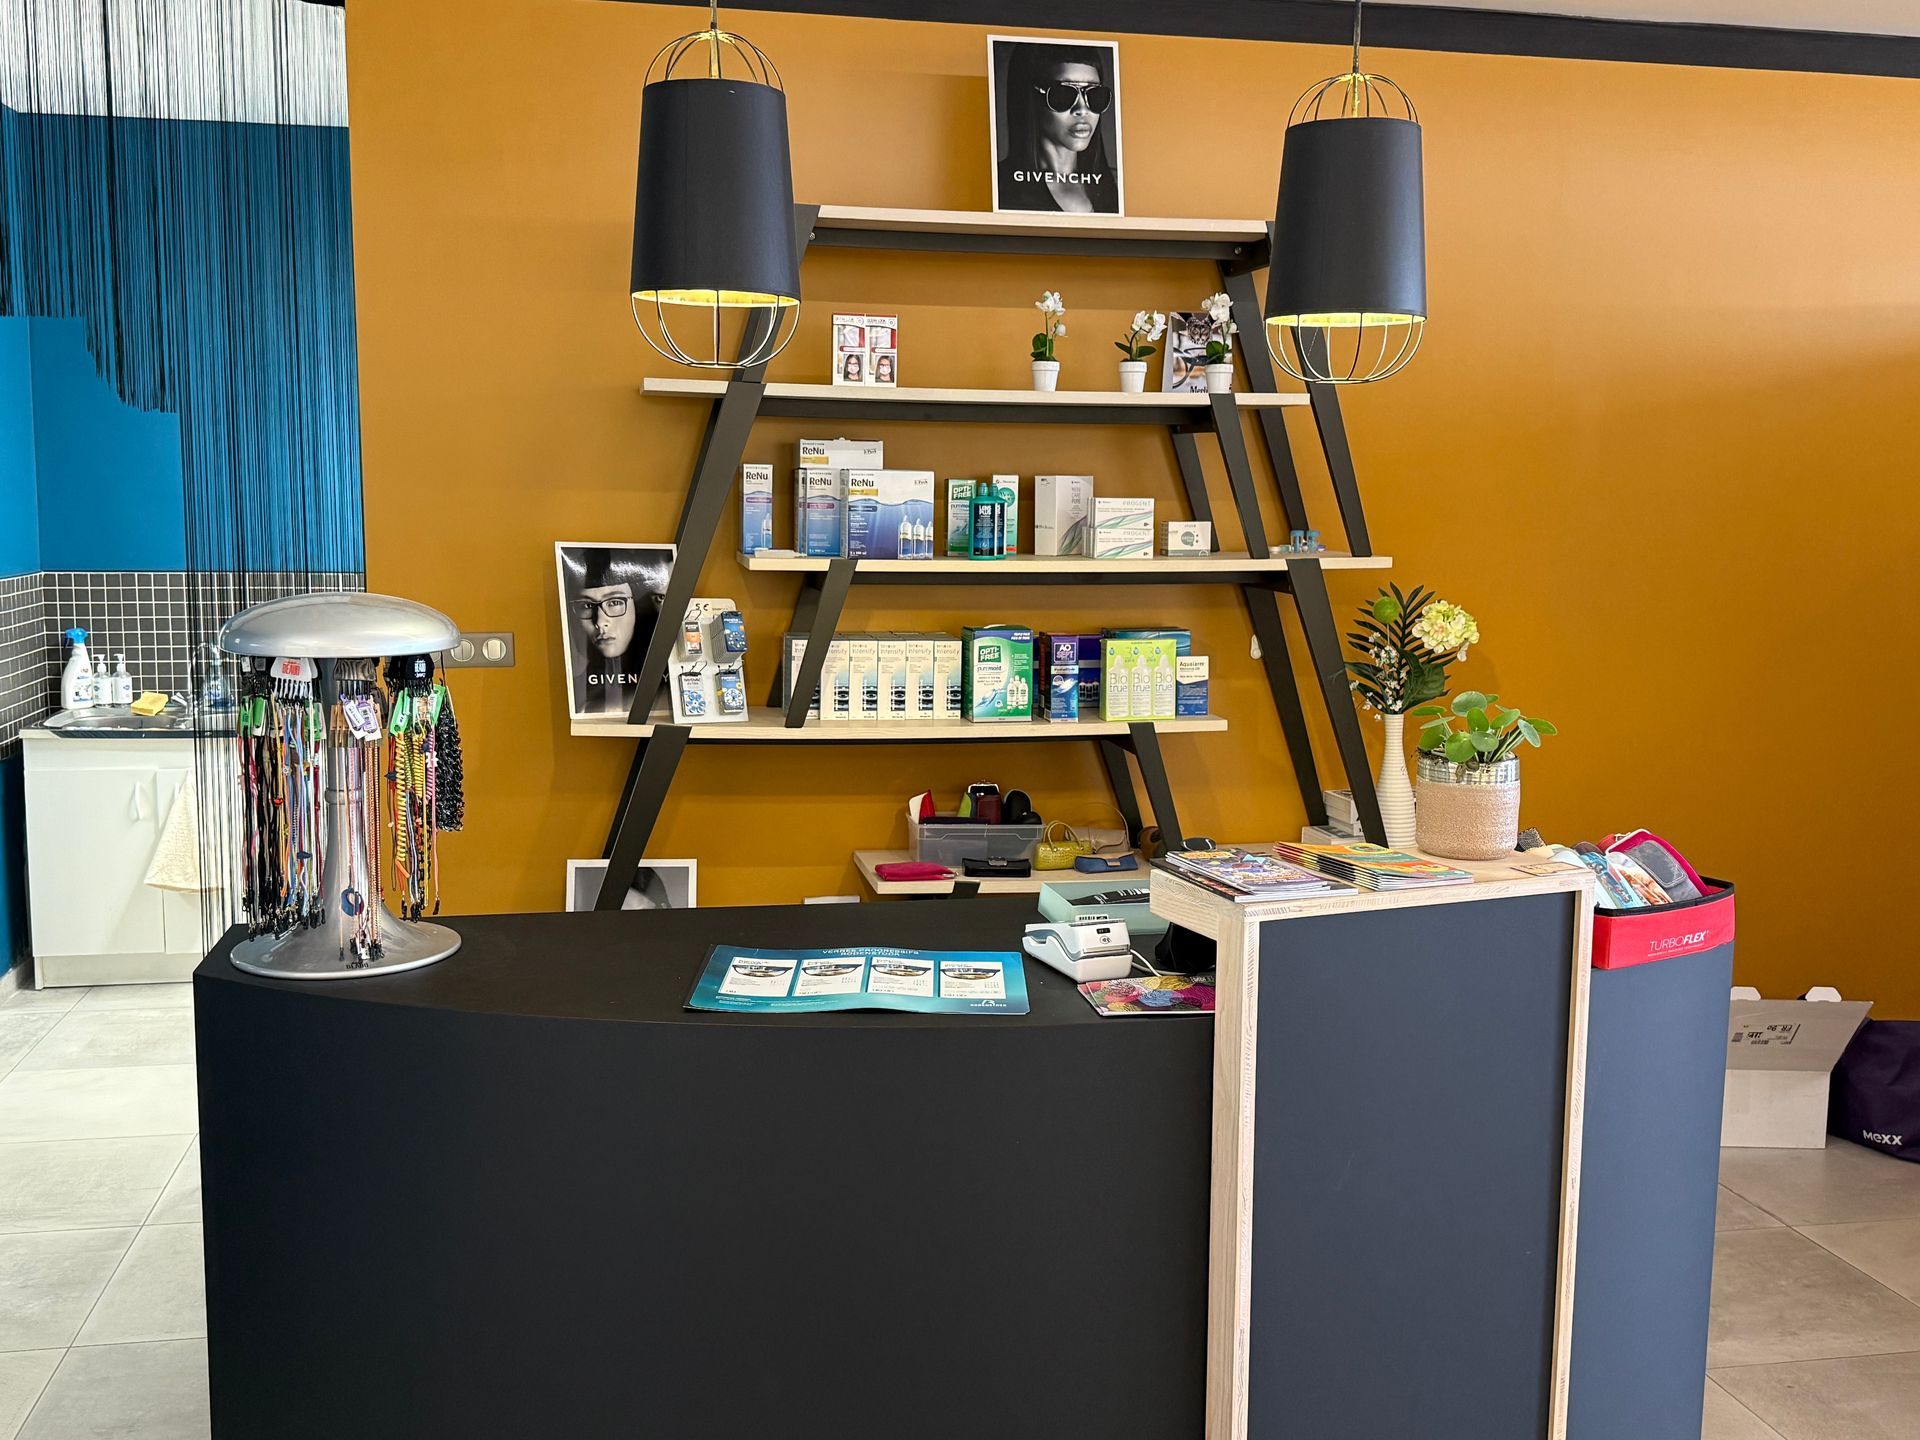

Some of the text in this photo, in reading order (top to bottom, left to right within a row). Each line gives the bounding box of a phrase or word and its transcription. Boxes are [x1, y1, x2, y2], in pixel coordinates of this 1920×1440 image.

[1013, 170, 1103, 185] GIVENCHY
[802, 446, 825, 455] ReNu
[745, 471, 769, 480] ReNu
[809, 477, 832, 486] ReNu
[851, 478, 875, 487] ReNu
[953, 491, 972, 500] FREE
[980, 652, 1000, 661] FREE
[587, 673, 669, 685] GIVENY
[1109, 684, 1128, 693] true
[1132, 684, 1151, 693] true
[1155, 684, 1173, 692] true
